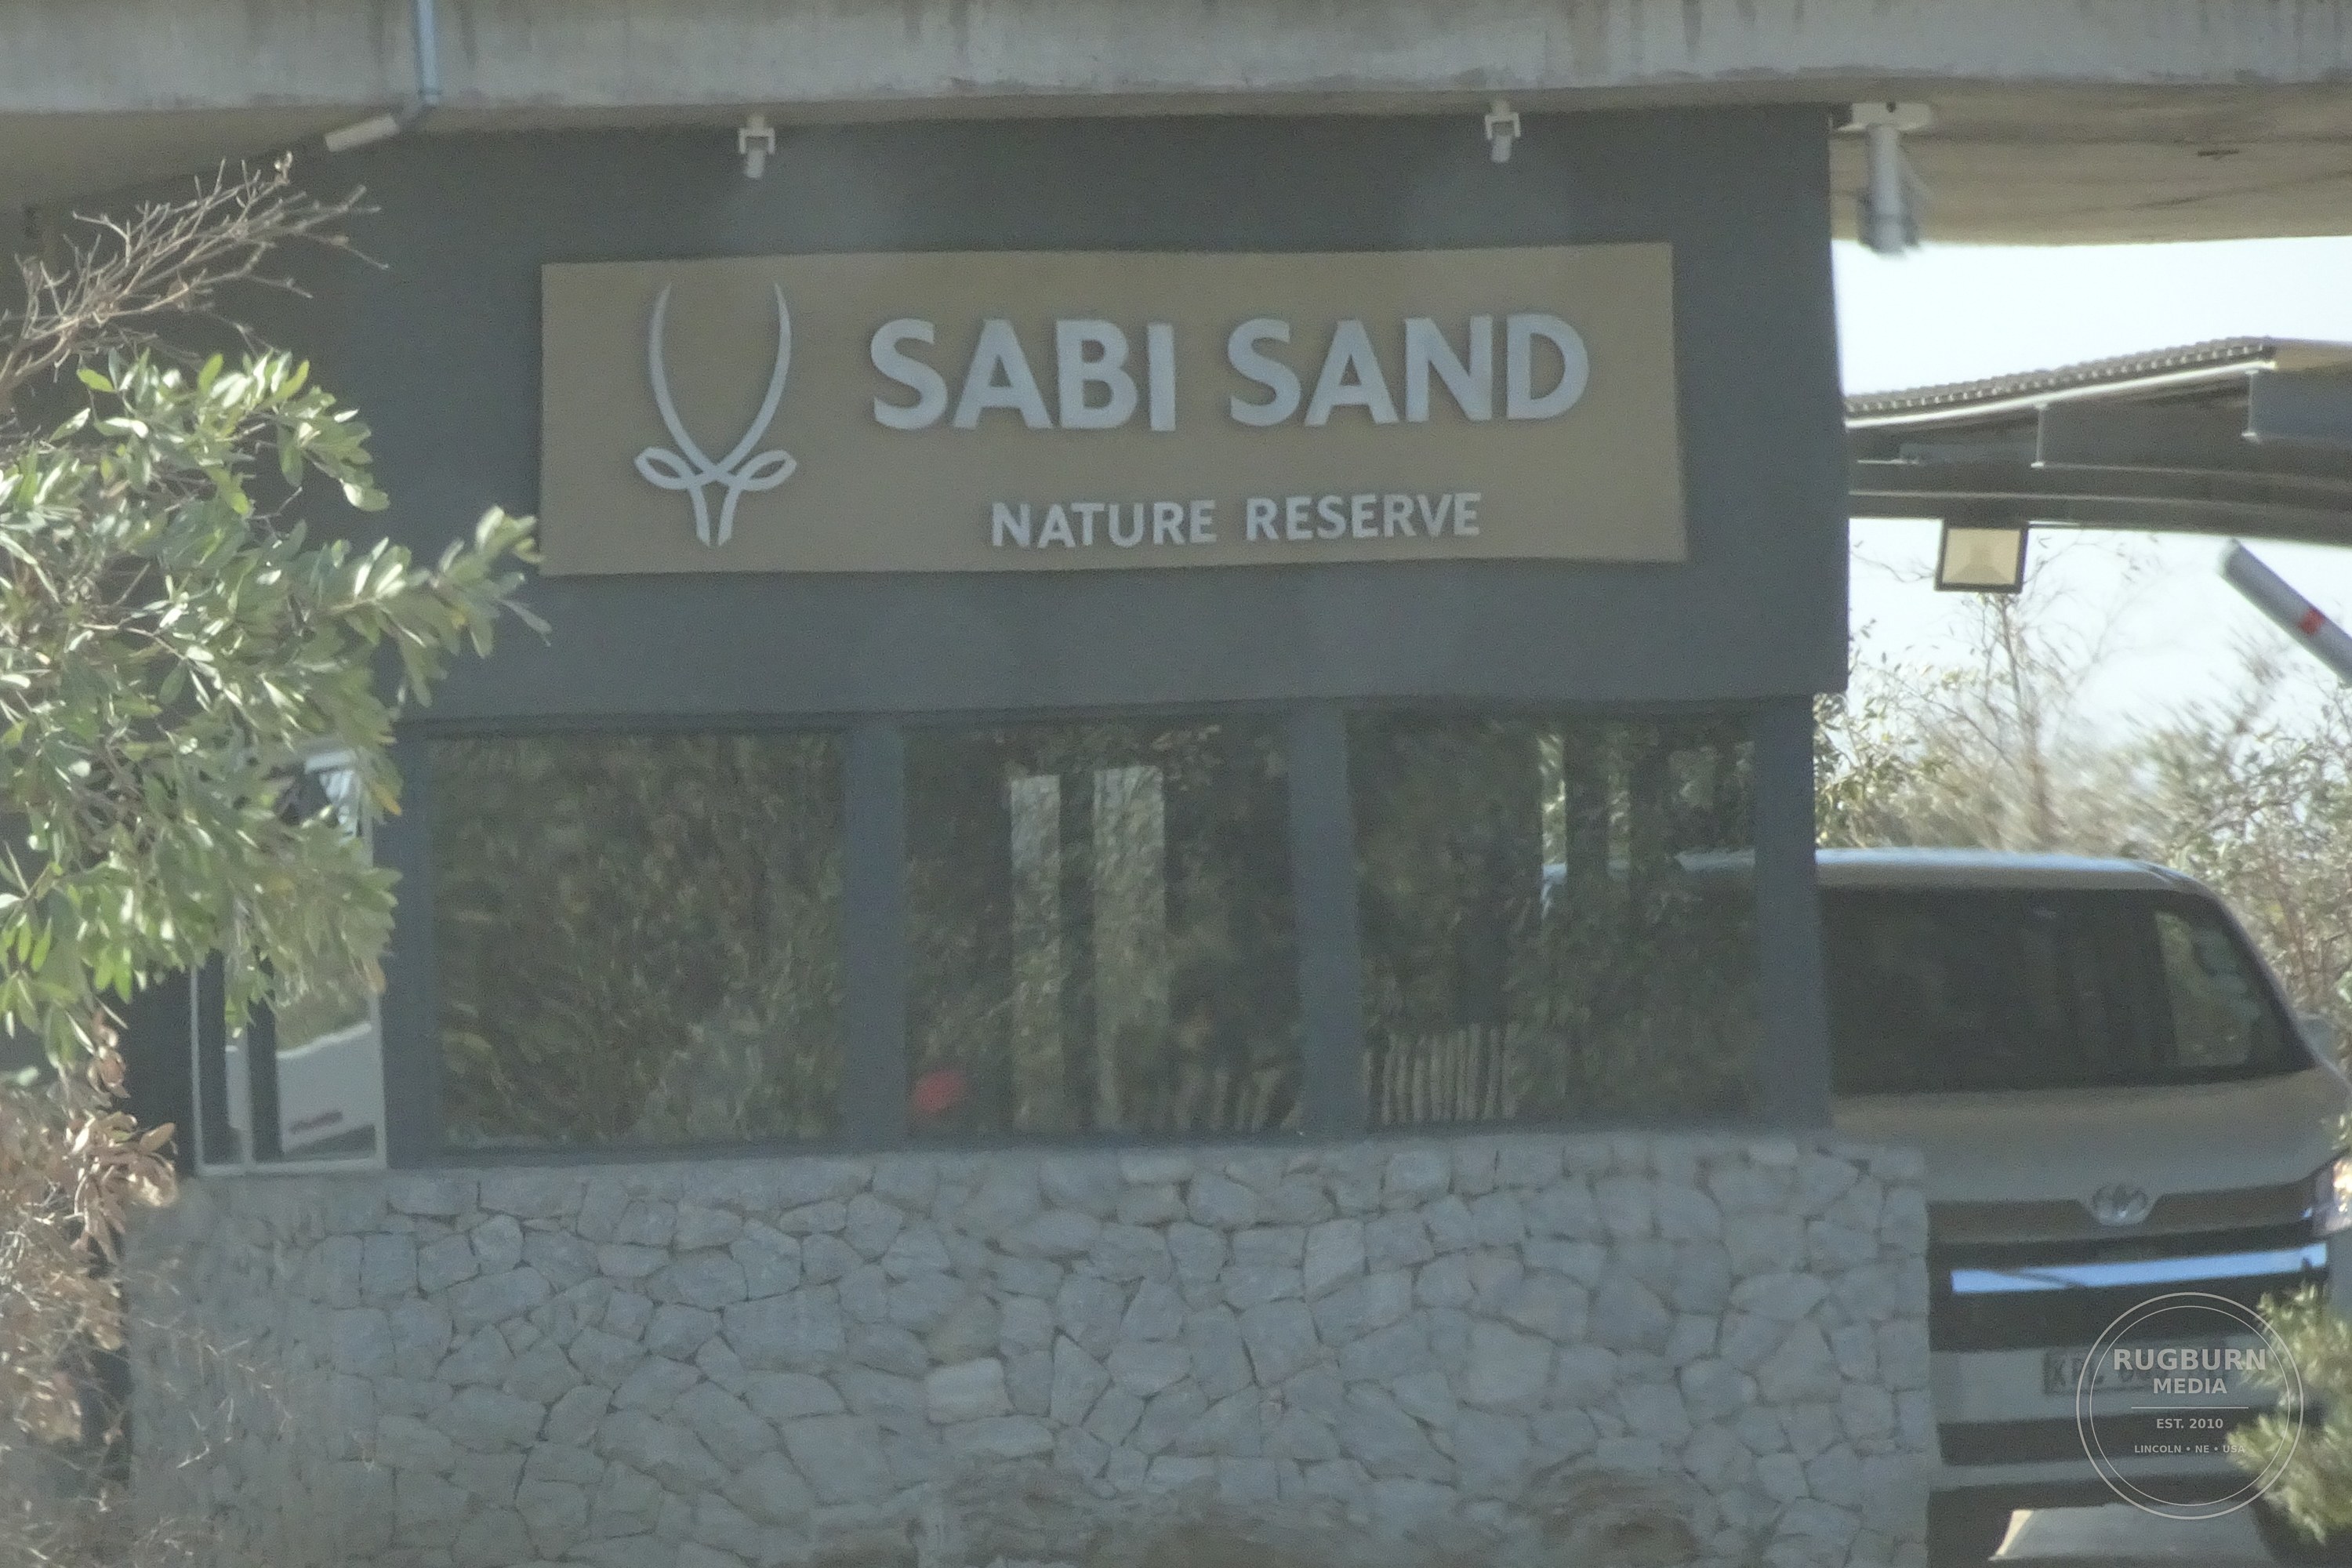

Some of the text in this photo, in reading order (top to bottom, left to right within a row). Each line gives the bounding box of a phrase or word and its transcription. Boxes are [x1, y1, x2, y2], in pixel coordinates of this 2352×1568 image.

[870, 313, 1589, 431] SABI SAND
[992, 492, 1482, 548] NATURE RESERVE
